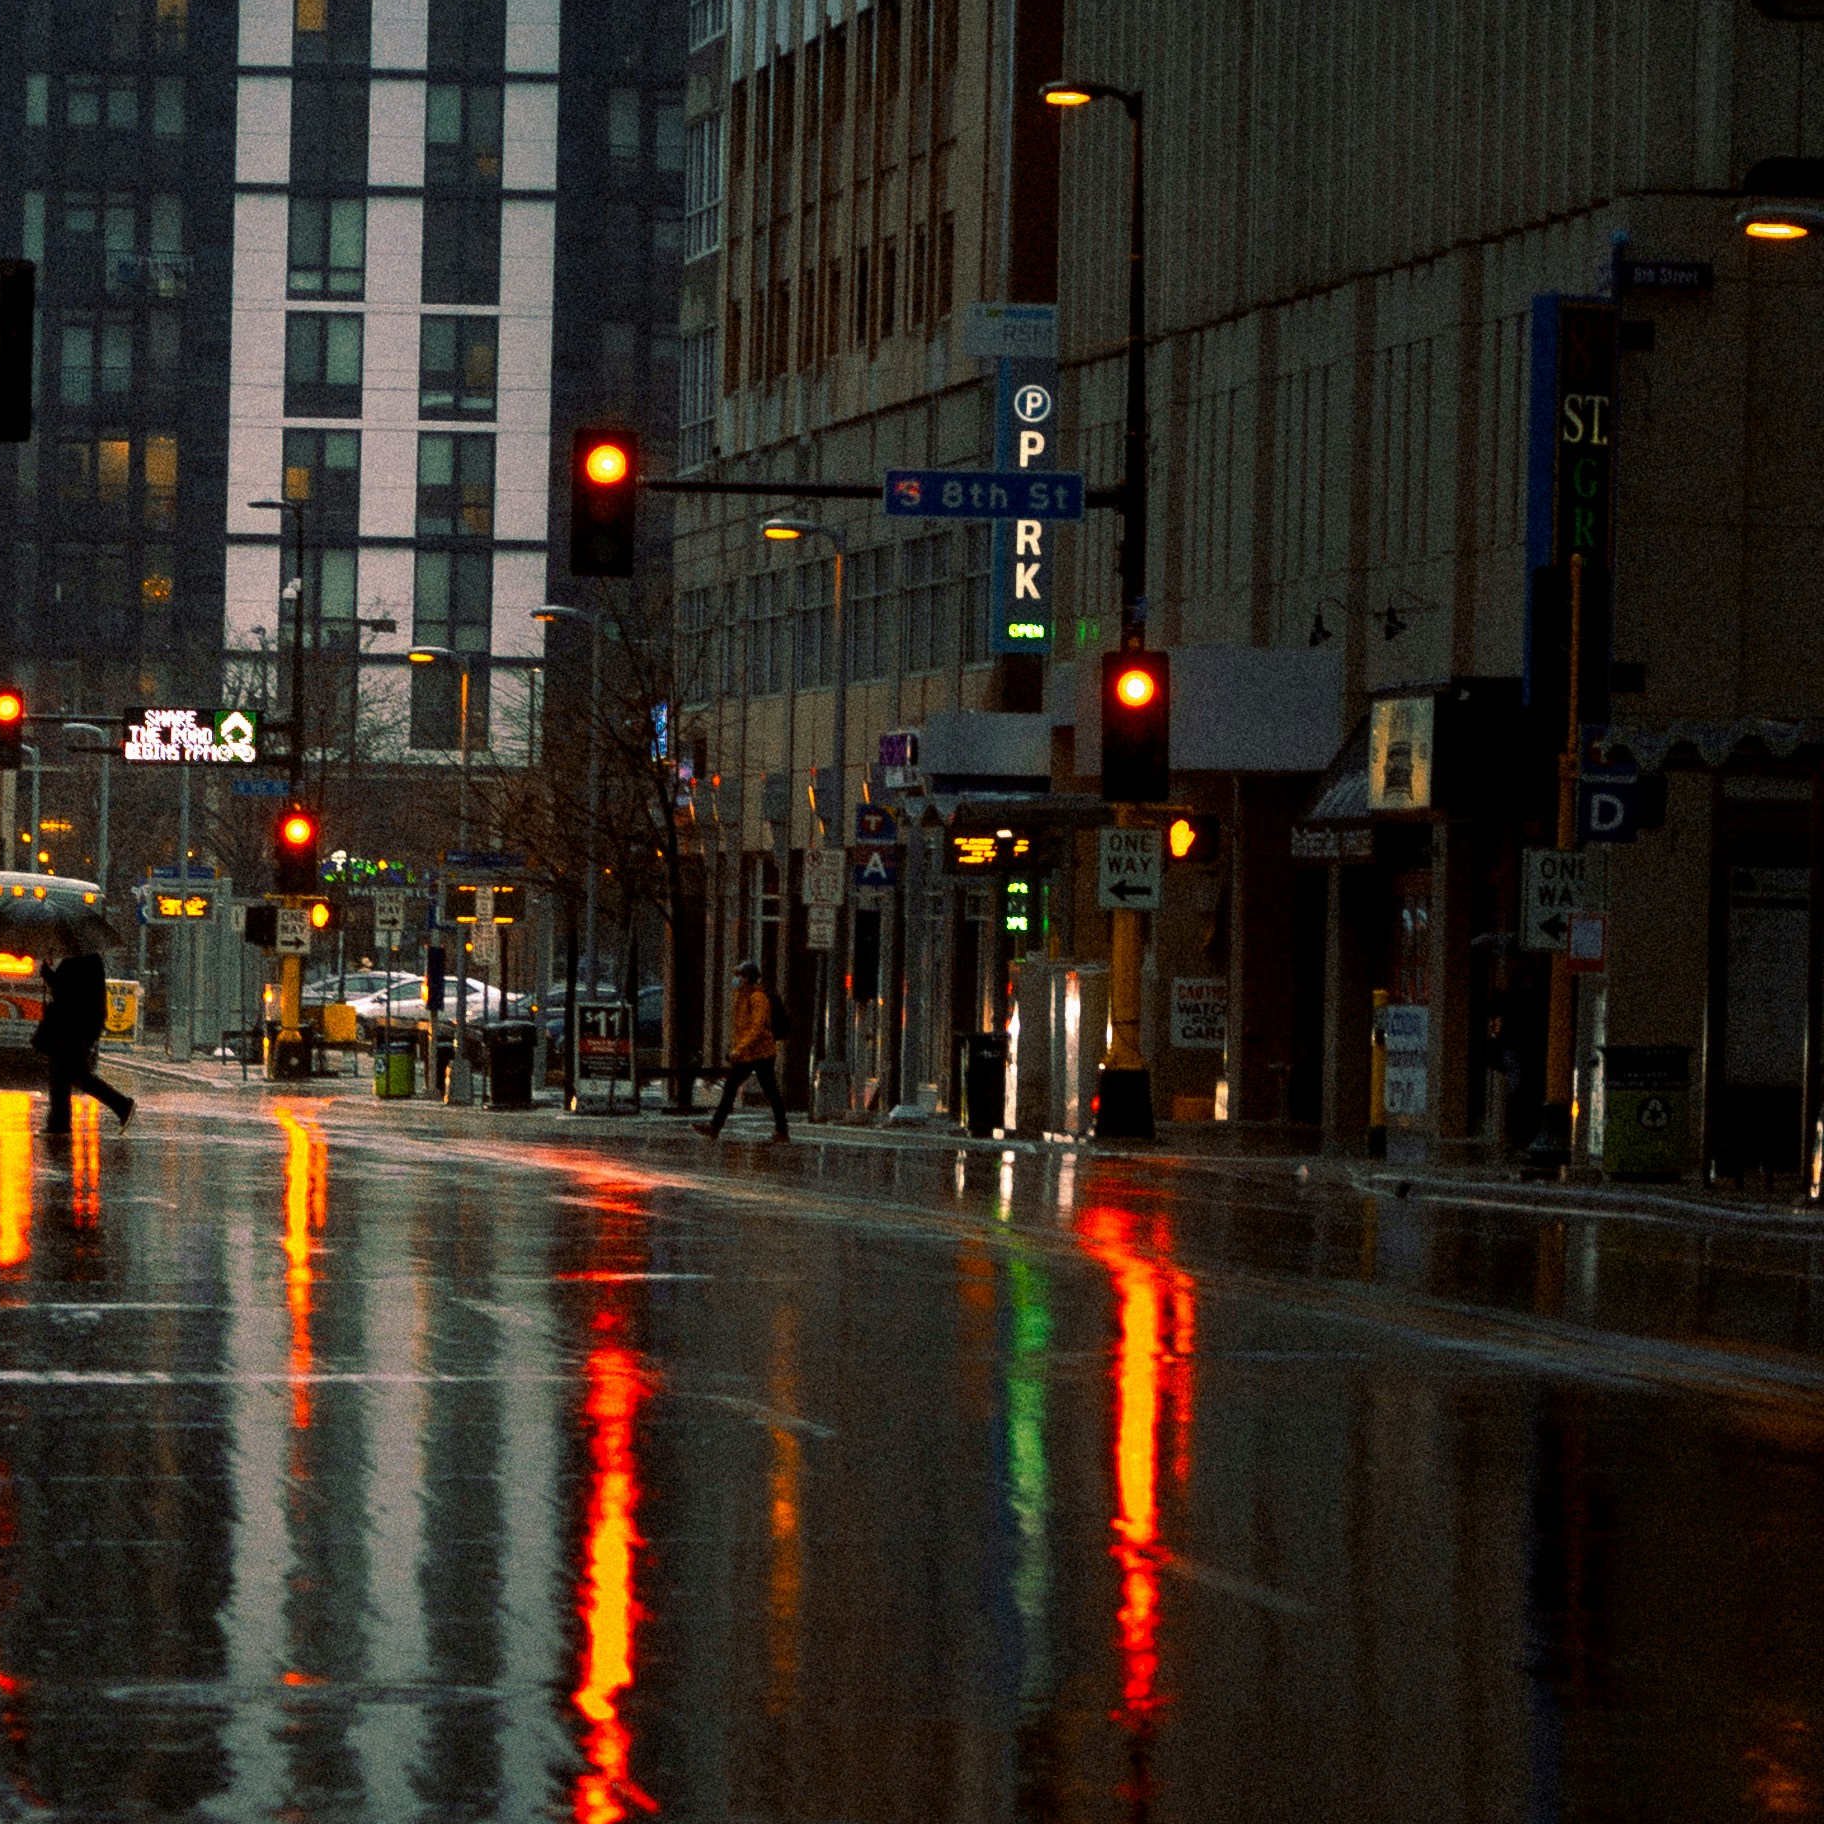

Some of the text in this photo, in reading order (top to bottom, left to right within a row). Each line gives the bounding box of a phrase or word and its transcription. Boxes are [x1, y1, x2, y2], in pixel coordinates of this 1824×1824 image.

[895, 477, 1070, 511] S 8th St
[1014, 430, 1046, 600] PRK
[1008, 623, 1045, 639] OPEN
[144, 710, 198, 727] SHARE
[128, 726, 214, 744] THE ROAD
[125, 742, 181, 760] BEGINS
[1590, 792, 1625, 832] D
[1108, 835, 1153, 852] ONE
[863, 851, 888, 879] A
[1108, 857, 1152, 873] WAY
[282, 911, 307, 922] ONE
